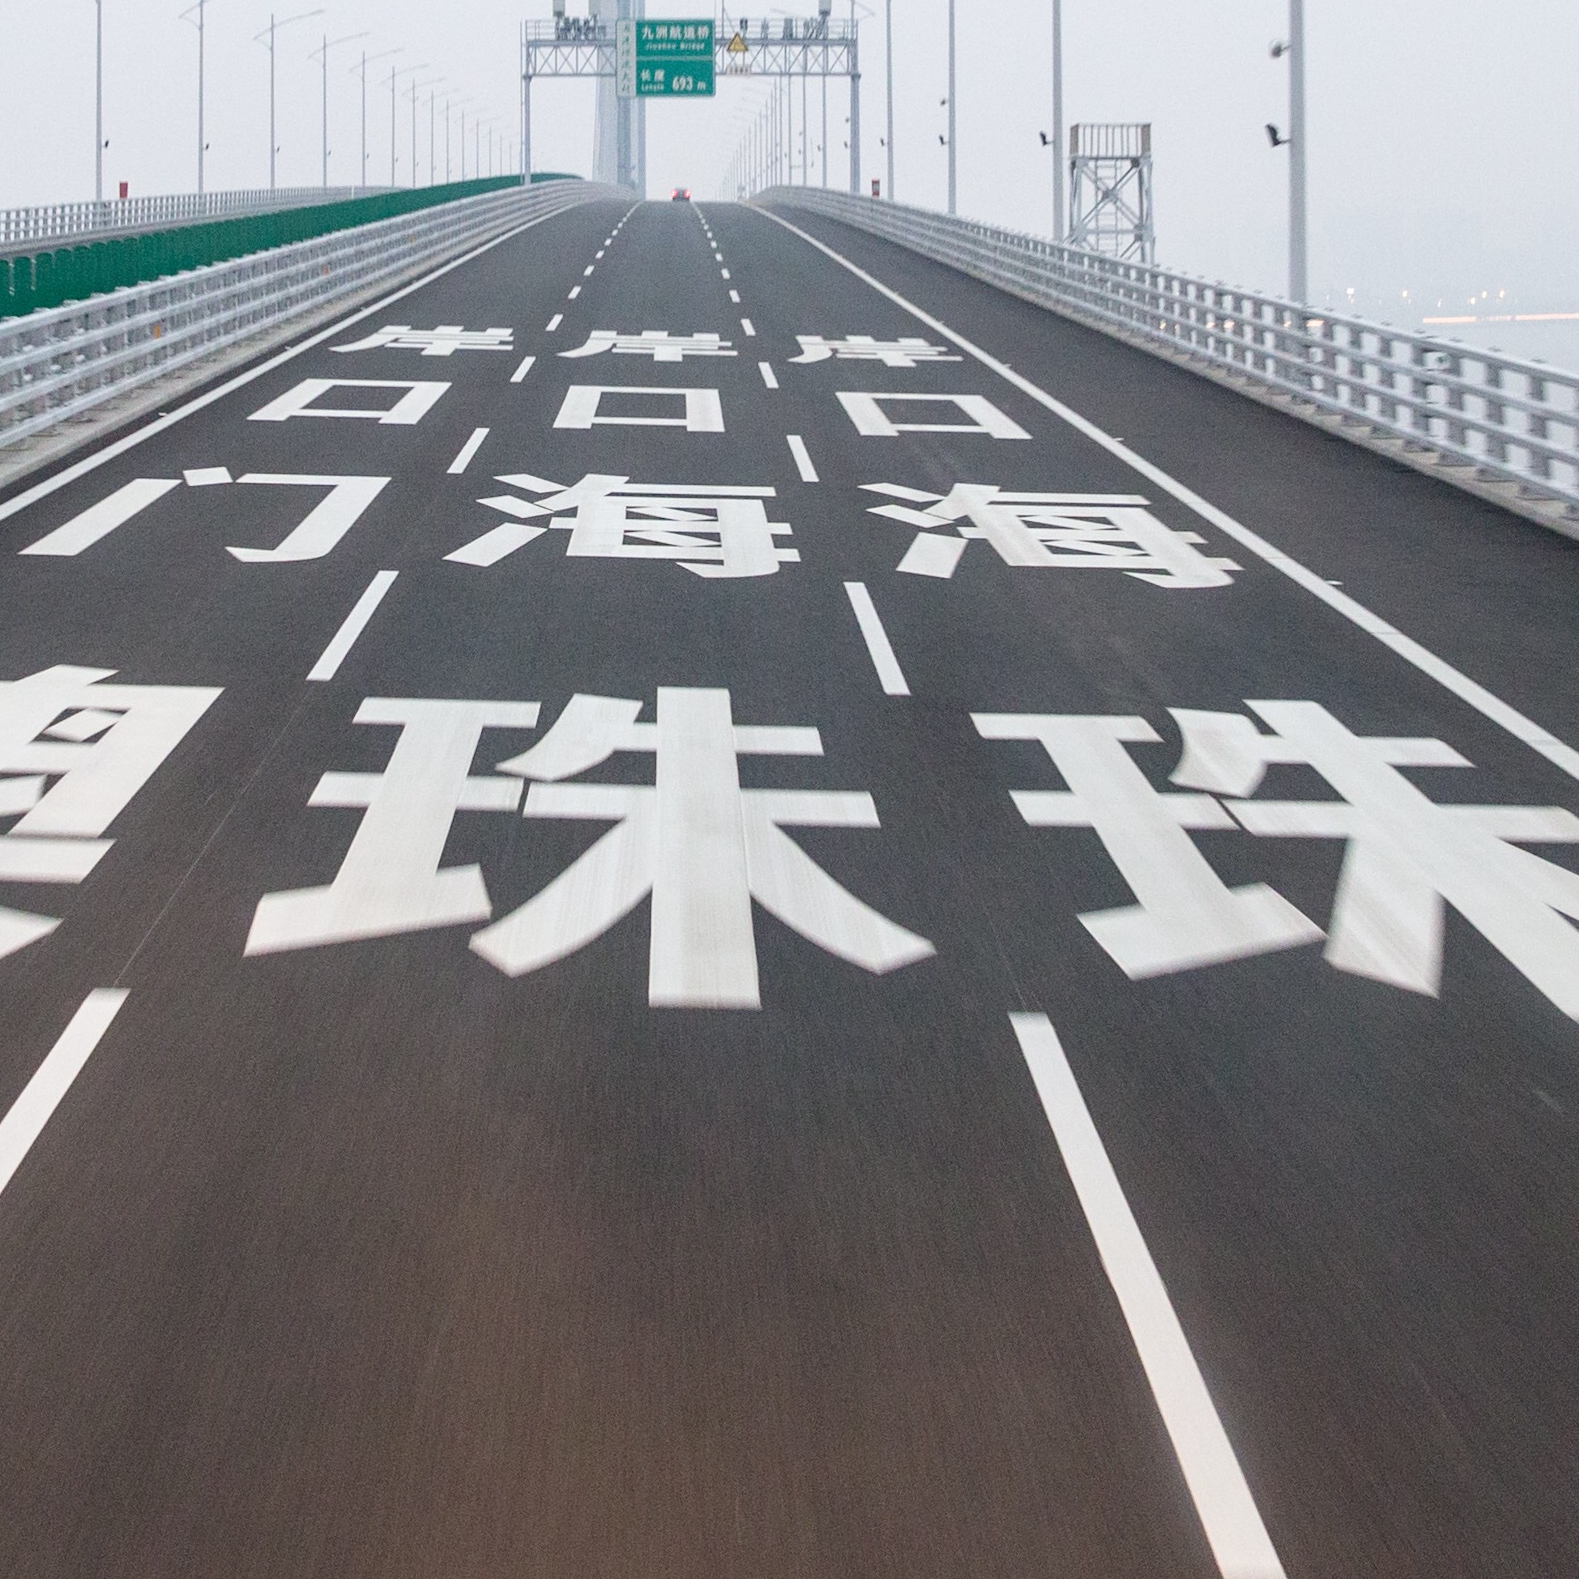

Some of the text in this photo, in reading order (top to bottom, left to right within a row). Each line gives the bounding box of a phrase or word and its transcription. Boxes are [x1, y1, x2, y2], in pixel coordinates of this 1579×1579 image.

[642, 25, 709, 40] 九洲航道桥
[672, 76, 706, 91] 693 m
